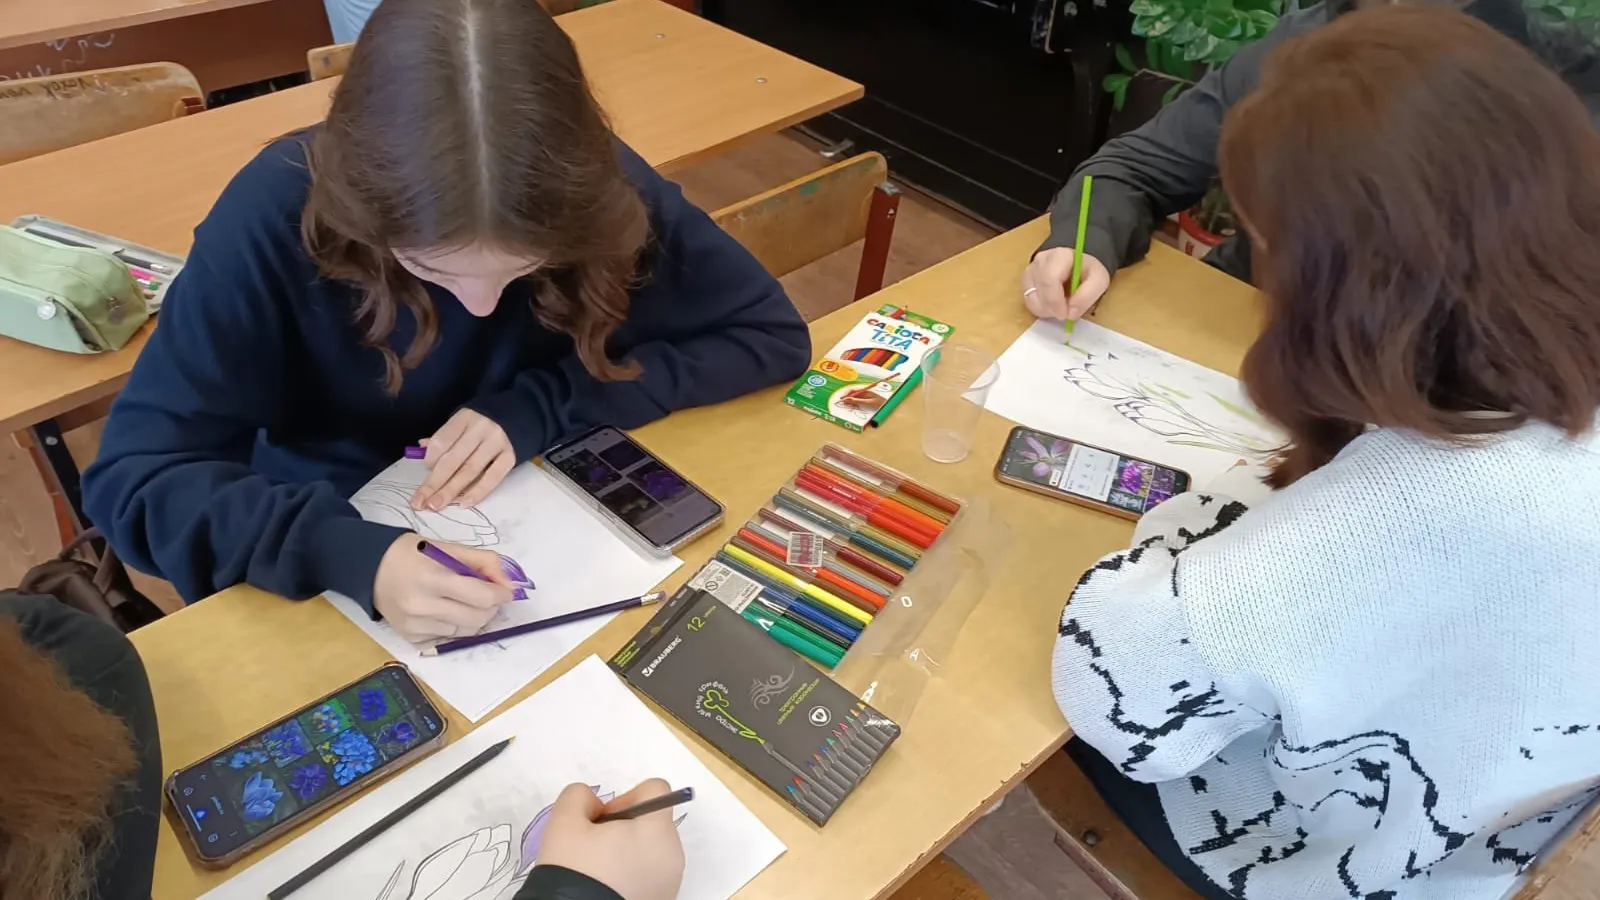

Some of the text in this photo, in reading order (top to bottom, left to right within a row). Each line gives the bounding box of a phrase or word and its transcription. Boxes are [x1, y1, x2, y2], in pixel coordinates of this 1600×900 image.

[866, 318, 931, 345] CARIOCA
[687, 615, 705, 632] 12
[650, 635, 683, 670] BRAUBERG
